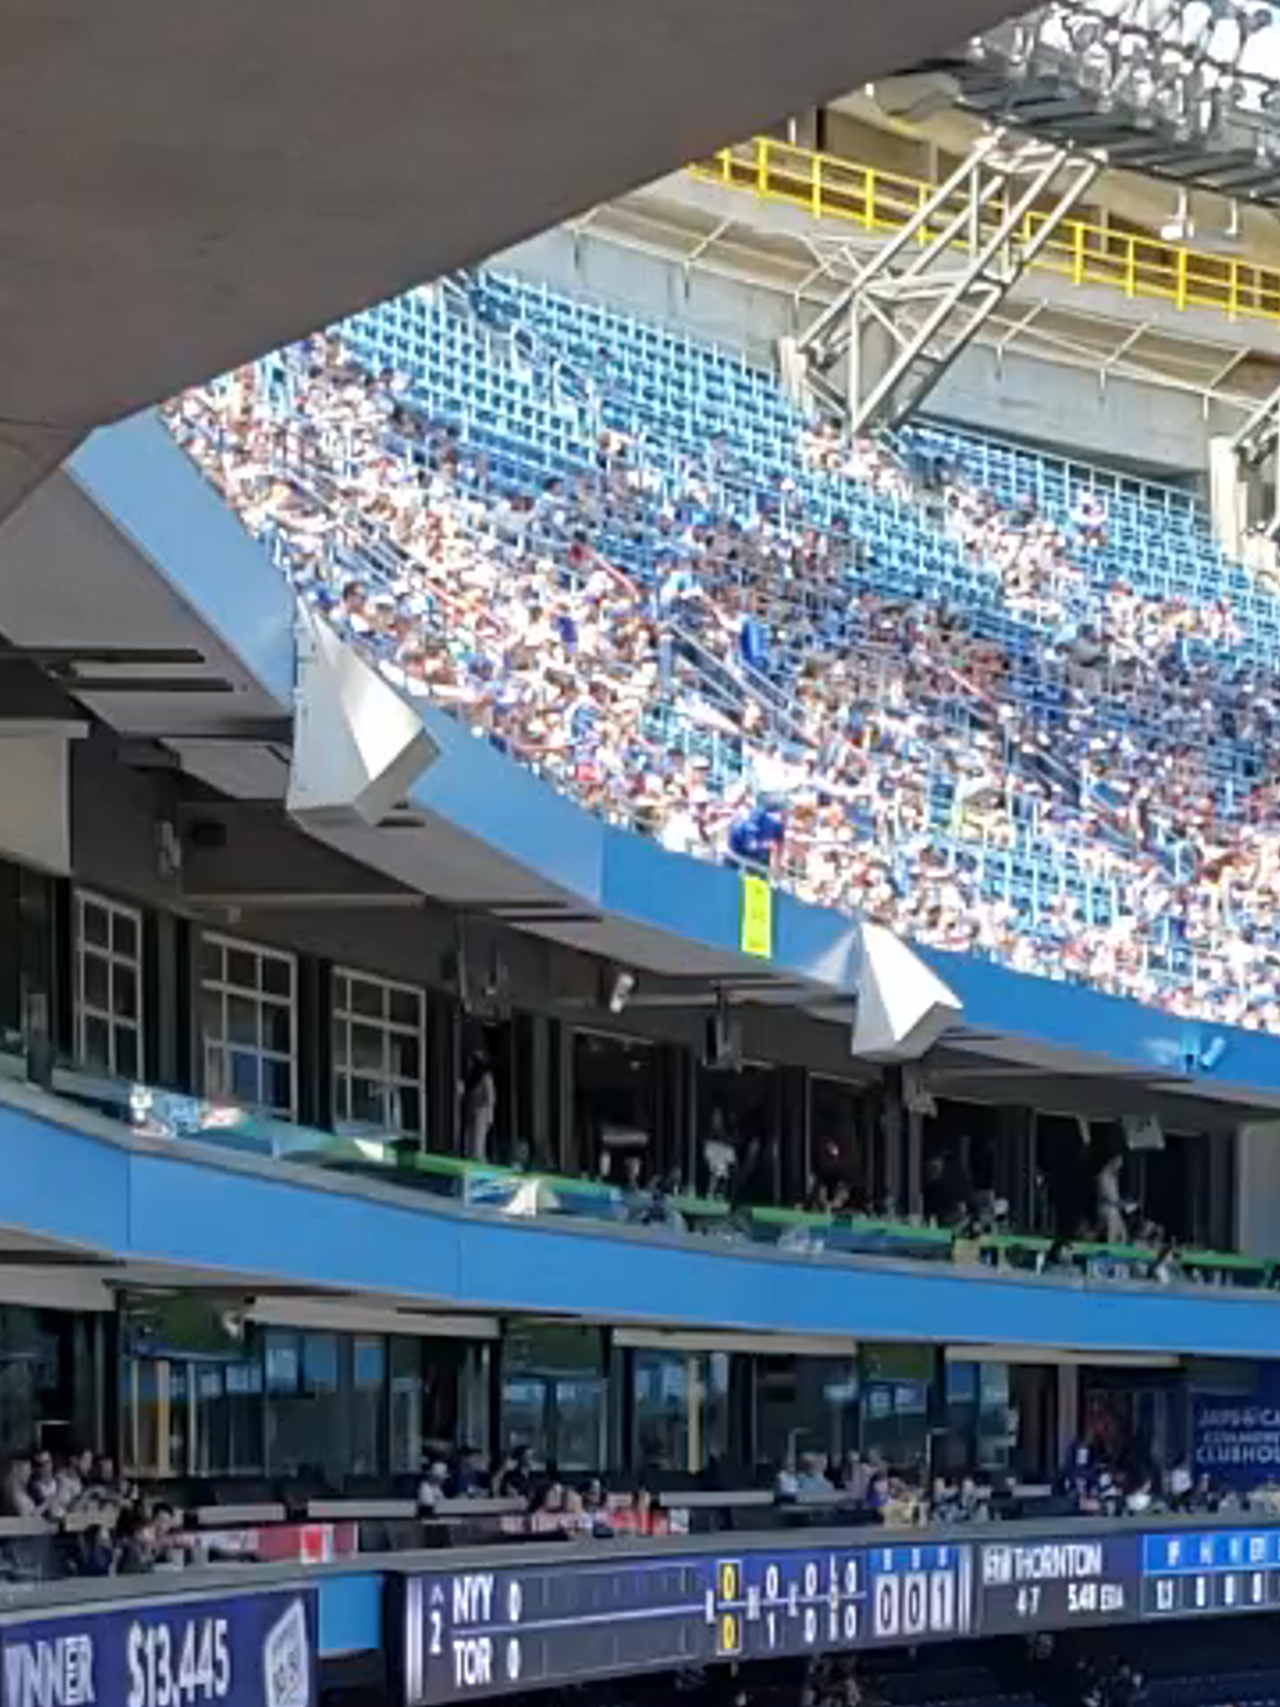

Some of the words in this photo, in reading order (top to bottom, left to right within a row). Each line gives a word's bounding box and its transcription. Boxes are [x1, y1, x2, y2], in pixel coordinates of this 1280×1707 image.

[1015, 1543, 1102, 1581] THORNTON
[452, 1573, 494, 1625] NYY
[723, 1563, 735, 1600] 0
[766, 1564, 779, 1599] 0
[805, 1561, 818, 1597] 0
[845, 1558, 857, 1594] 0
[430, 1611, 442, 1655] 2
[452, 1637, 492, 1687] TOR
[723, 1615, 735, 1650] 0
[768, 1611, 776, 1649] 1
[844, 1603, 857, 1639] 0
